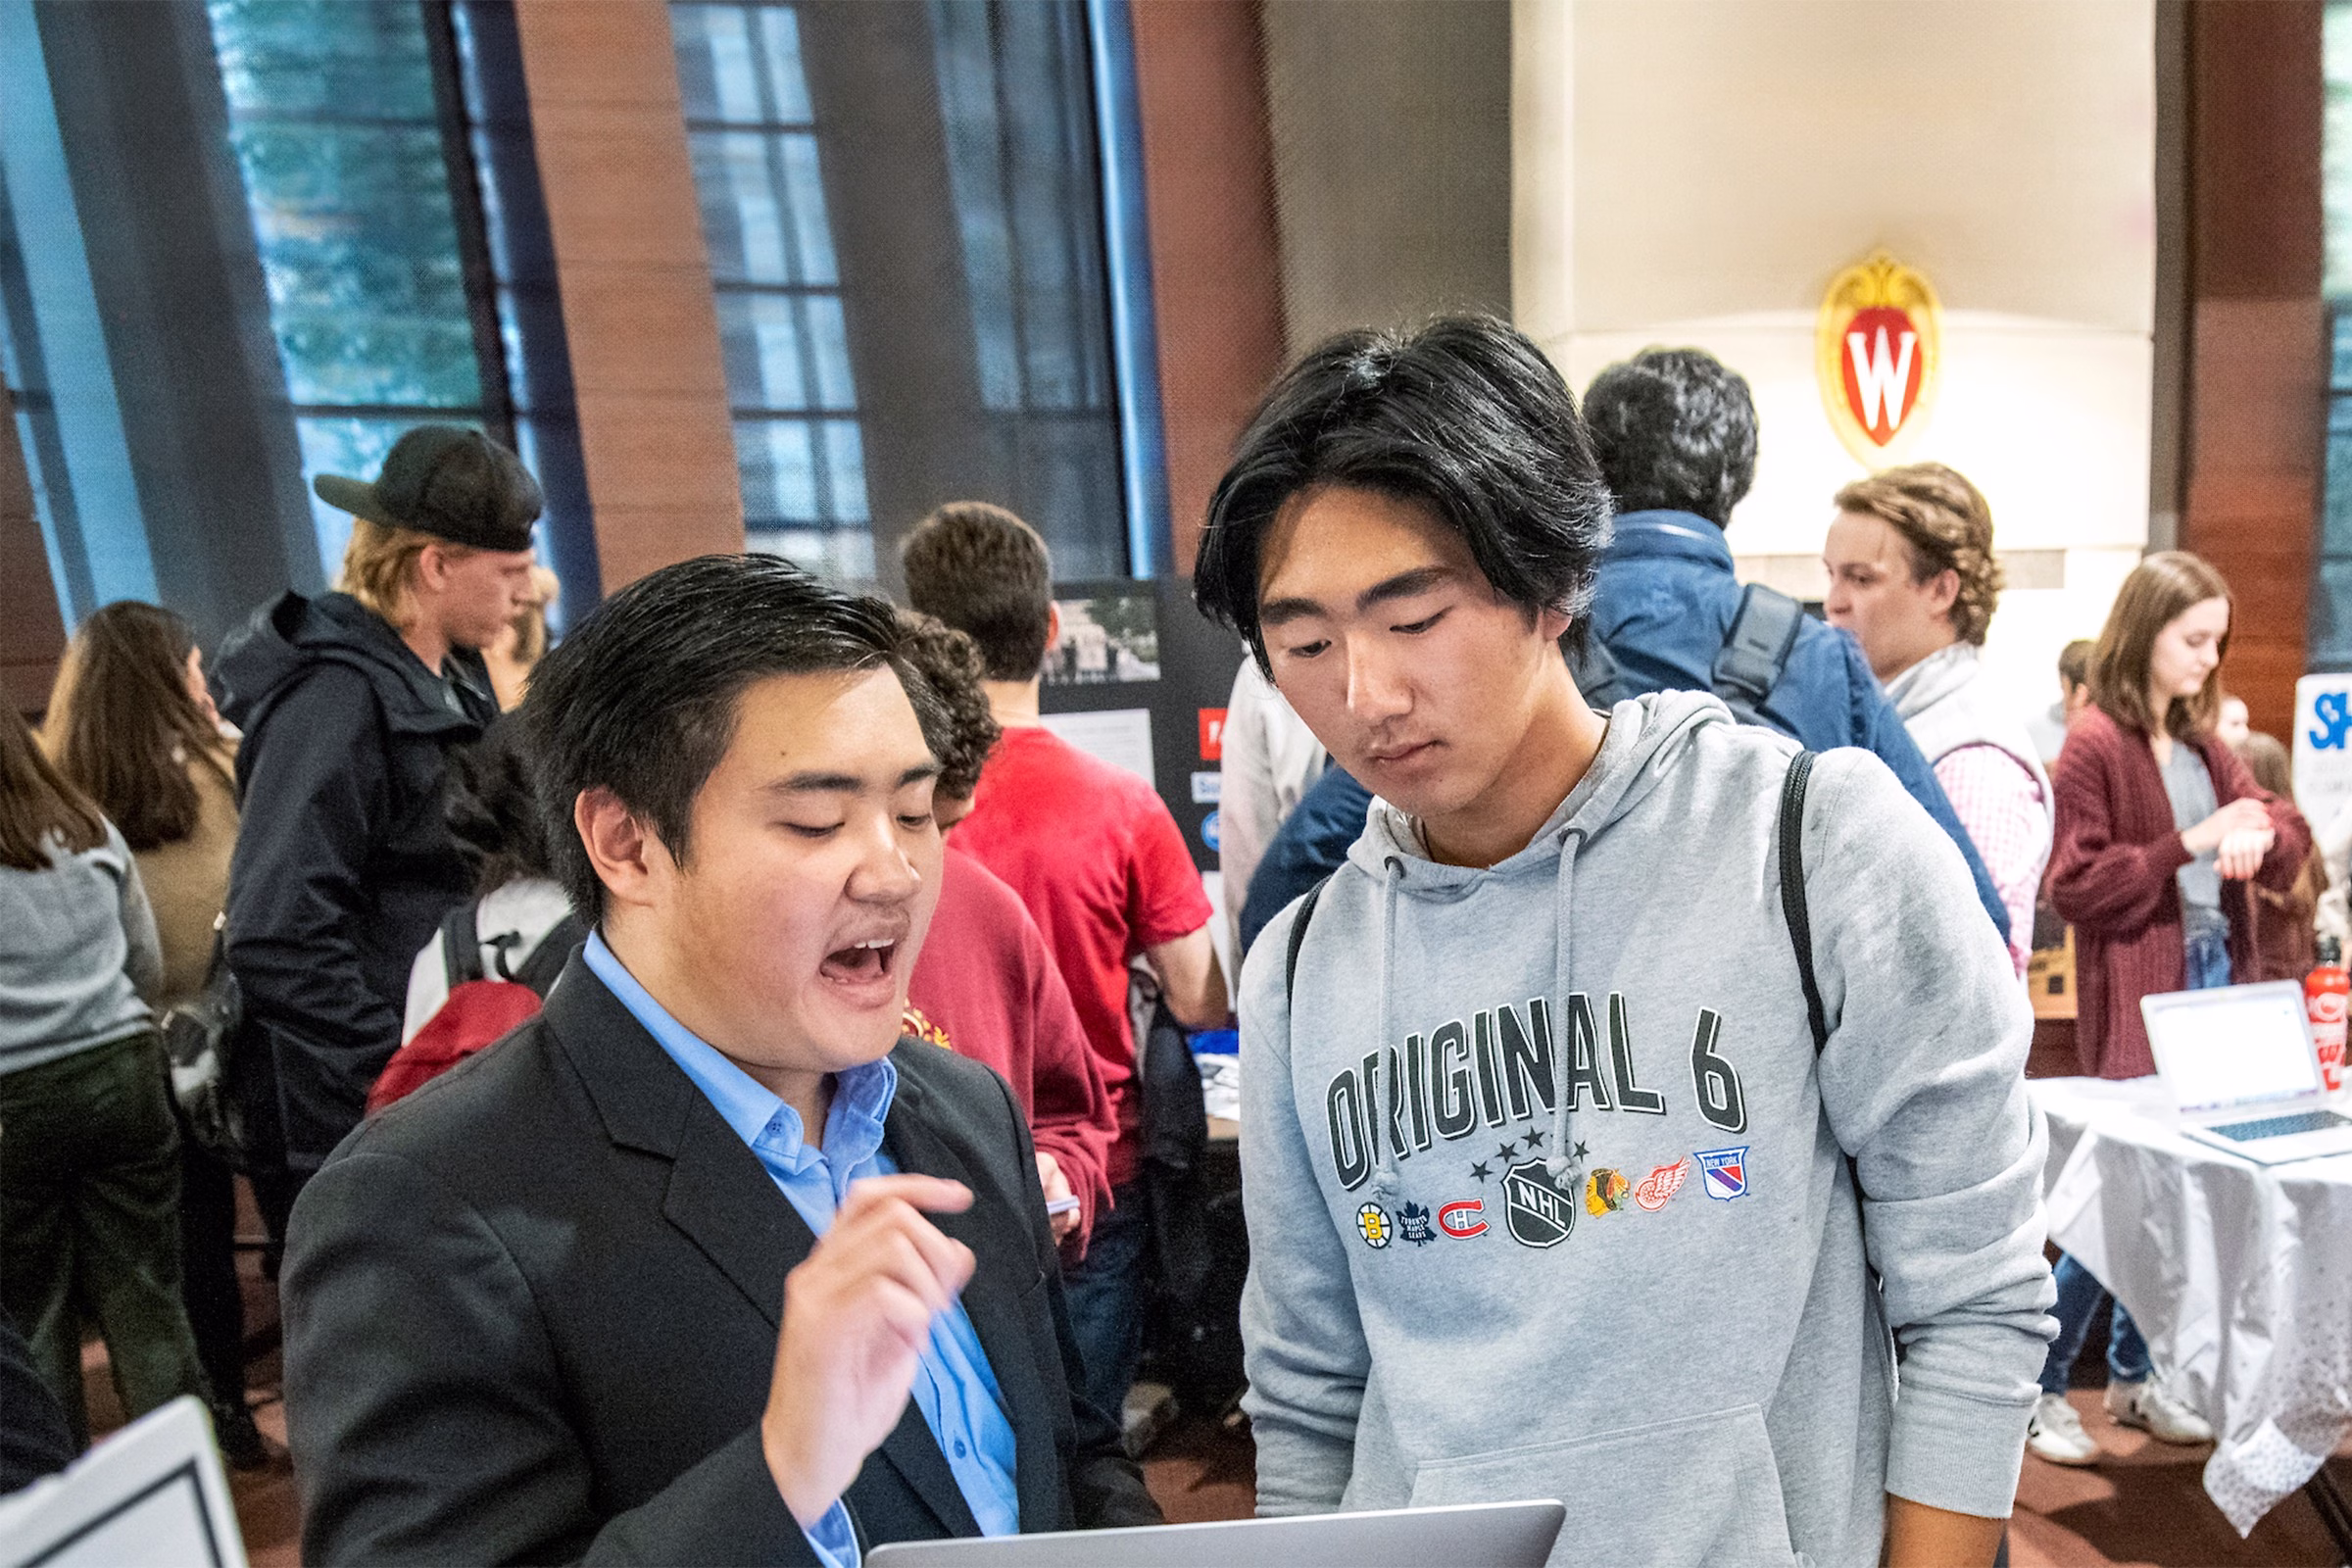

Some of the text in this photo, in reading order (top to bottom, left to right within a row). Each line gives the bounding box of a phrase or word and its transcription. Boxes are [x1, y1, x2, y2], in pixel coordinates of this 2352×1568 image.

[1847, 325, 1917, 431] W
[1325, 991, 1747, 1192] ORIGINAL 6
[1363, 1212, 1384, 1240] B
[1401, 1214, 1428, 1226] TORONTO
[1517, 1181, 1566, 1228] NHL
